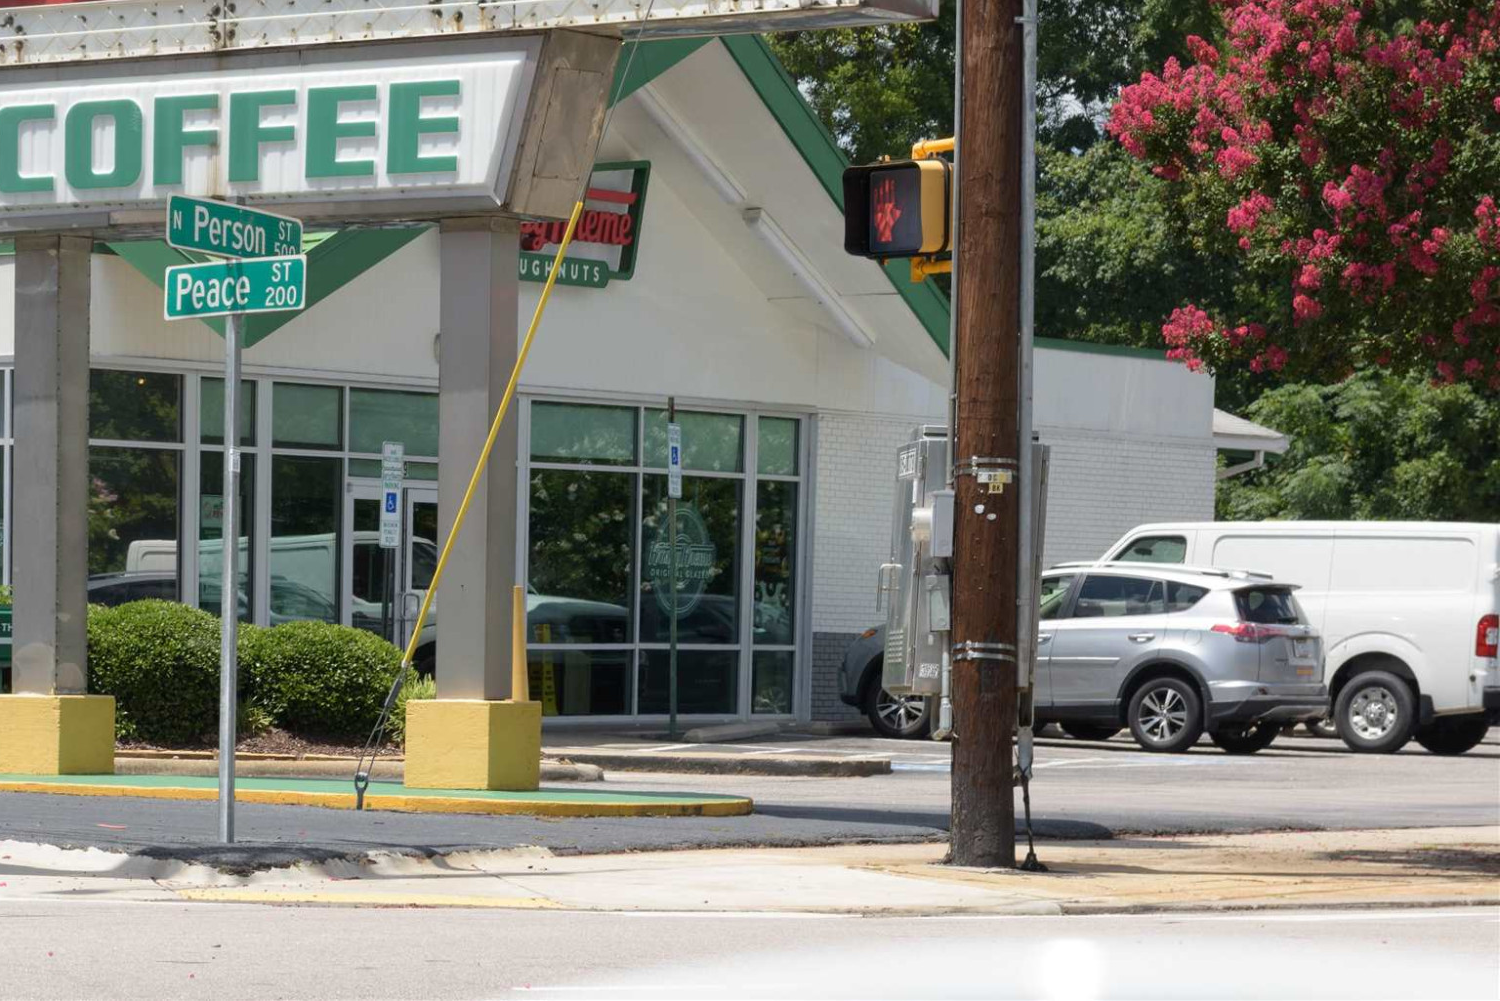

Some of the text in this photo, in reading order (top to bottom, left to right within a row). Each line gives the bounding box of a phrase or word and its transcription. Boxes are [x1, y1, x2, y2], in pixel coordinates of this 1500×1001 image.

[173, 205, 293, 255] N Person ST
[176, 262, 292, 311] Peace ST
[519, 258, 600, 282] UGHNUTS
[265, 285, 297, 306] 200
